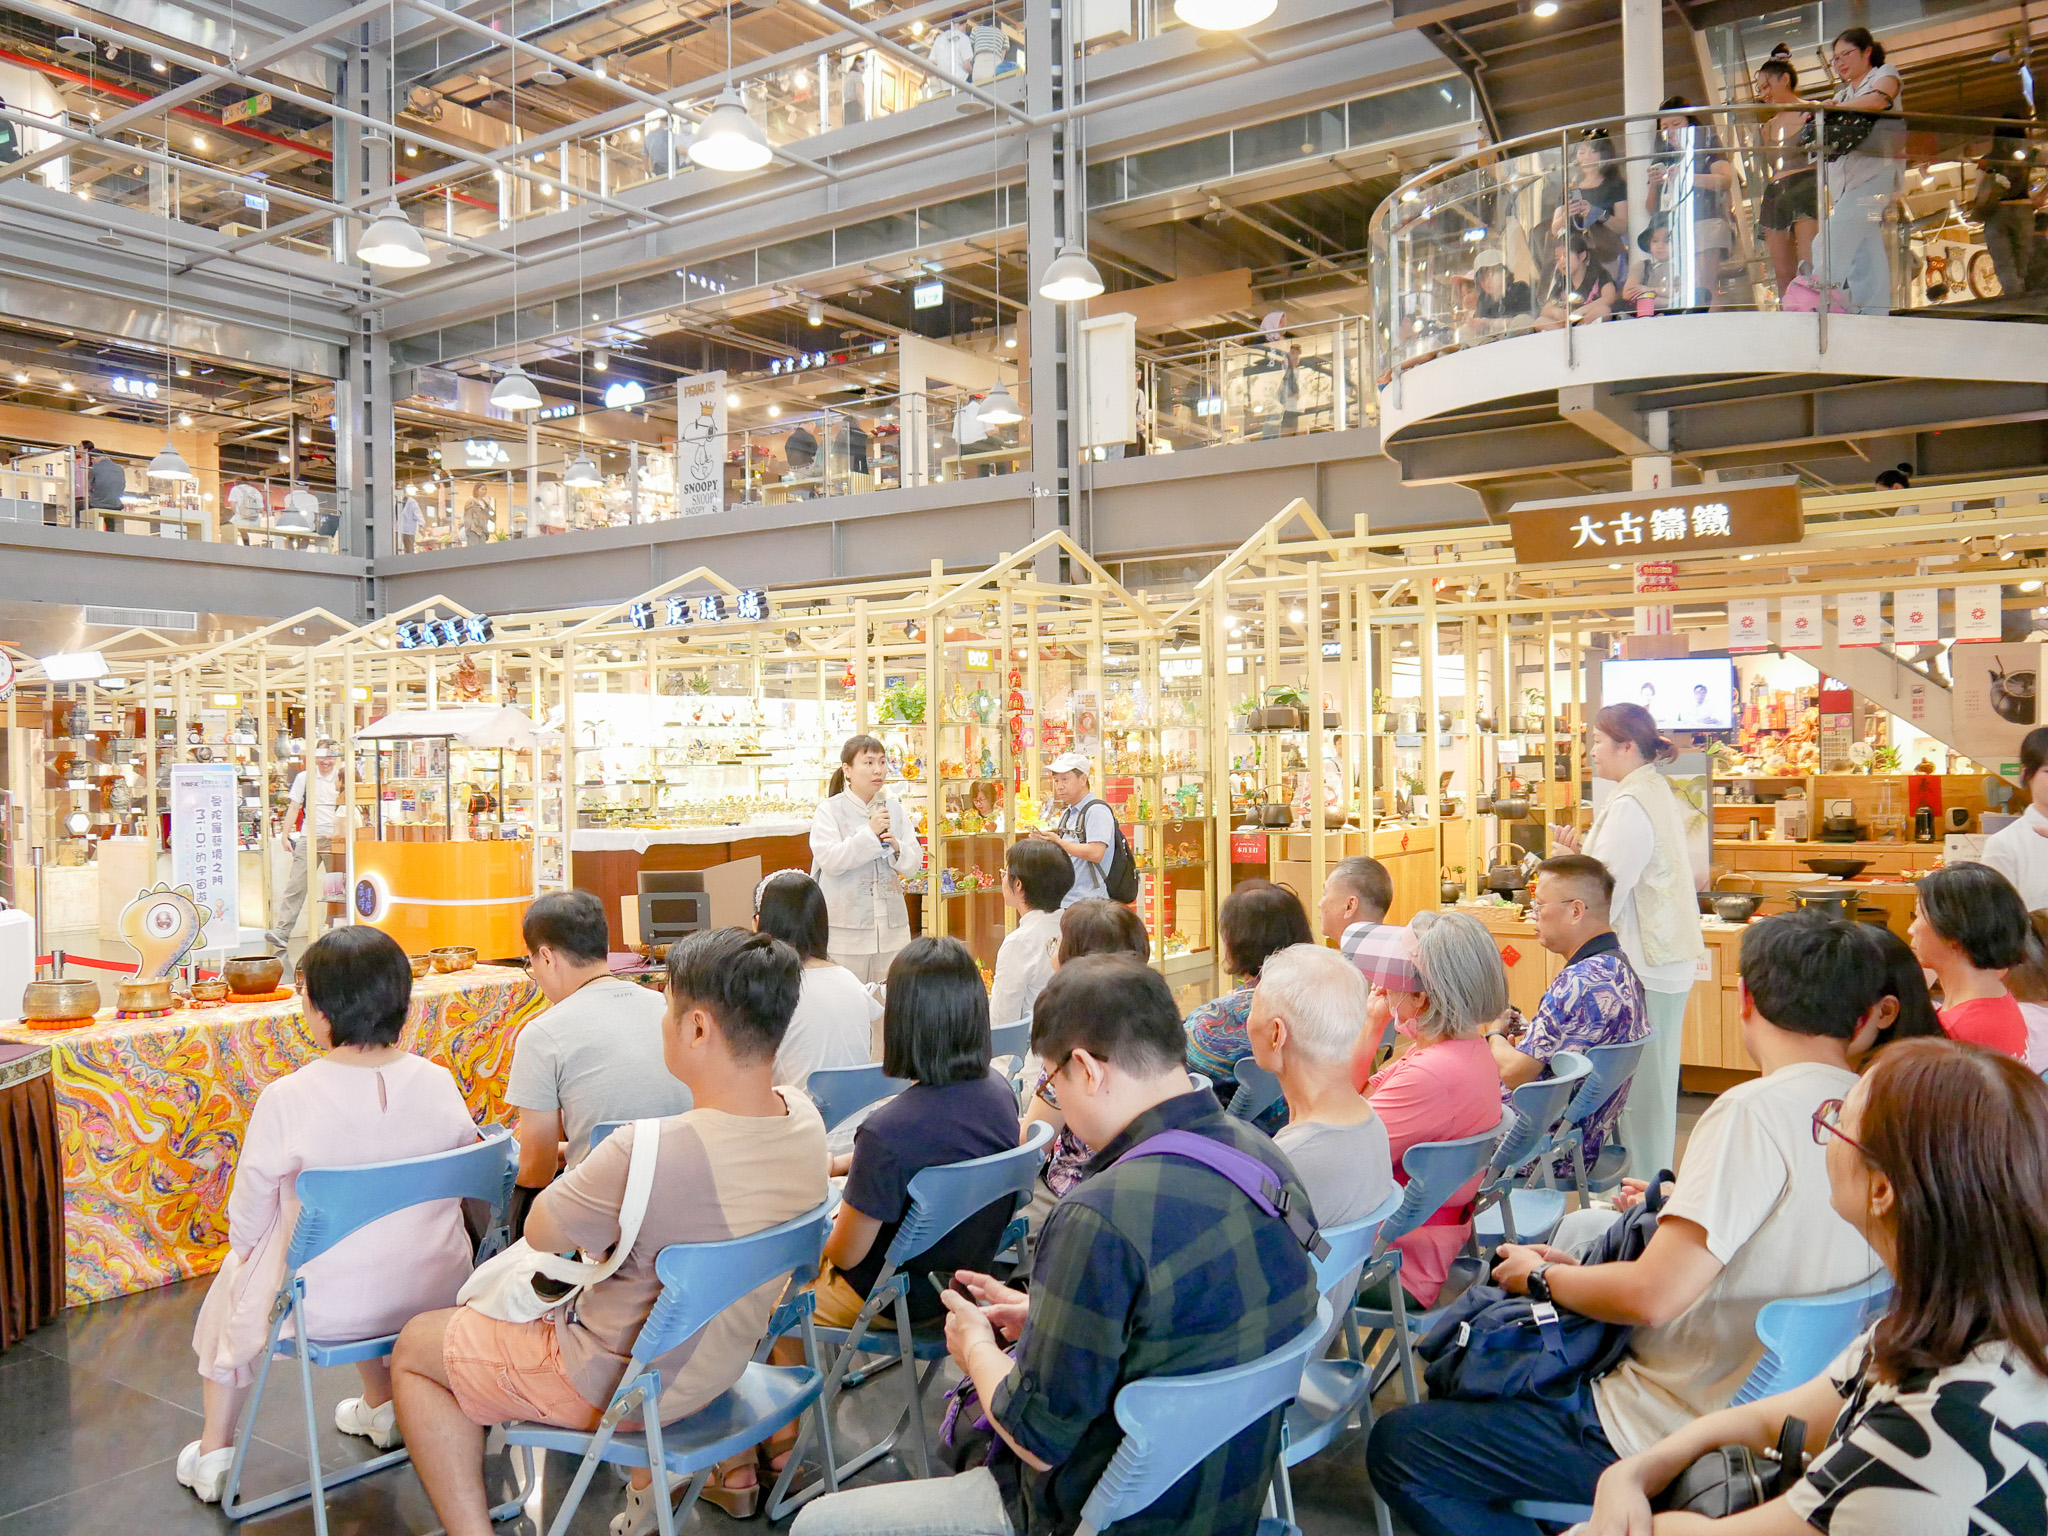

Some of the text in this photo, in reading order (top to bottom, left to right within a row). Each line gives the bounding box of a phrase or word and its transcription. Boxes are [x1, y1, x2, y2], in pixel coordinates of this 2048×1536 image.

[684, 381, 715, 398] PEANUTS
[684, 480, 718, 494] SNOOPY
[691, 490, 719, 505] SNOOPY
[685, 505, 705, 516] SNOOPY
[1569, 503, 1731, 549] 大古鑄鐵
[968, 650, 989, 667] B02
[211, 795, 223, 886] 曼陀羅藝境之門
